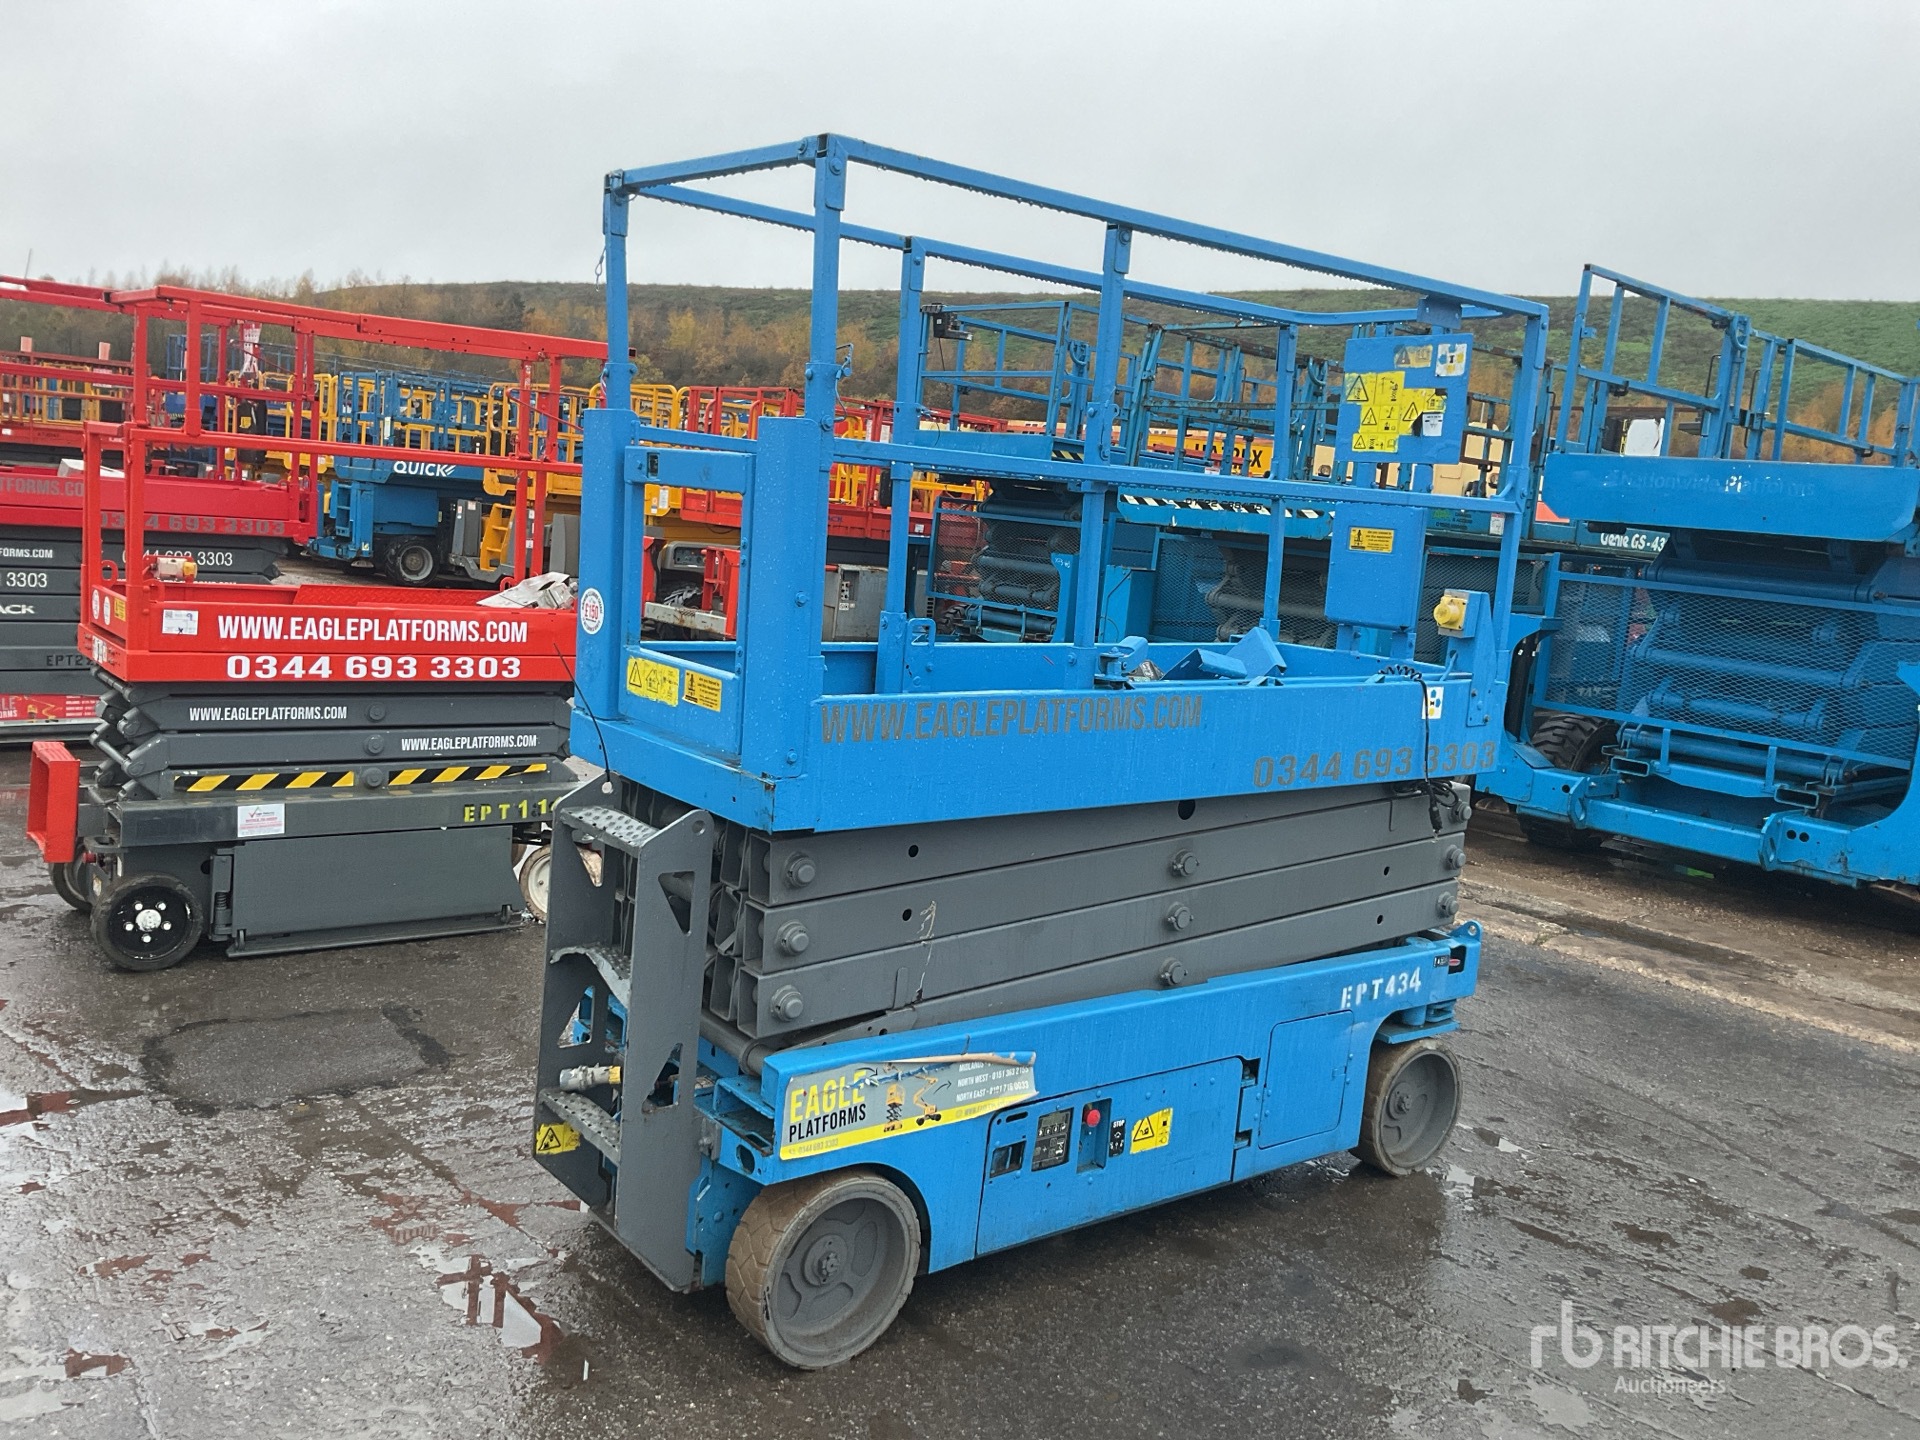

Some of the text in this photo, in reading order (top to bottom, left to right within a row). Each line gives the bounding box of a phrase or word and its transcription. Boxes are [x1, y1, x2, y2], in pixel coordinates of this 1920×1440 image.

[393, 460, 448, 477] QUICK
[169, 517, 216, 532] 693
[225, 519, 285, 535] 3303
[1631, 533, 1667, 552] GS-43
[197, 551, 234, 567] 3303
[6, 572, 47, 588] 3303
[218, 615, 528, 643] WWW.EAGLEPLATFORMS.COM
[227, 655, 521, 679] 0344 693 3303
[189, 706, 347, 721] WWW.EAGLEPLATFORMS.COM
[822, 695, 1202, 744] WWW.EAGLEPLATFORMS.COM
[401, 735, 537, 751] WWW.EAGLEPLATFORMS.COM
[1253, 741, 1497, 788] 0344 693 3303
[464, 797, 561, 823] EPT11
[1340, 966, 1422, 1010] EPT434
[790, 1069, 868, 1124] EAGLE
[789, 1103, 867, 1142] PLATFORMS
[1113, 1119, 1126, 1128] STOP
